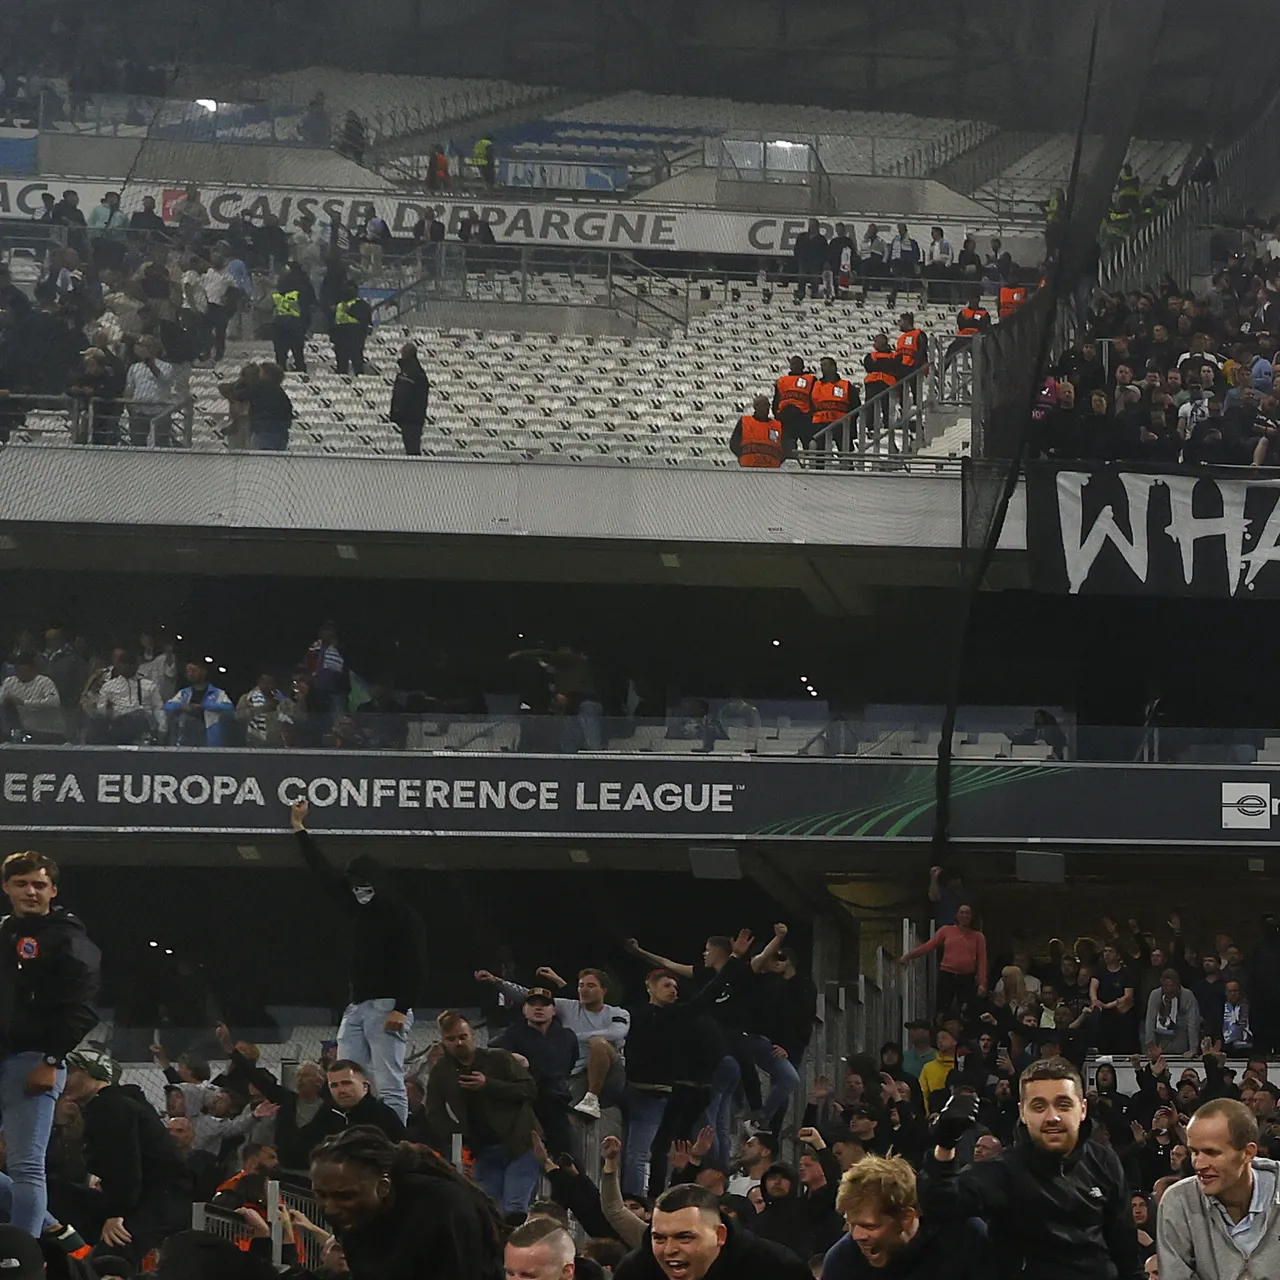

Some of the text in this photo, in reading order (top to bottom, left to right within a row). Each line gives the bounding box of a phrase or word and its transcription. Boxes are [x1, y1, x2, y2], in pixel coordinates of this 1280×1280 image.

[4, 771, 85, 804] EFA
[97, 774, 266, 807] EUROPA
[277, 775, 560, 811] CONFERENCE
